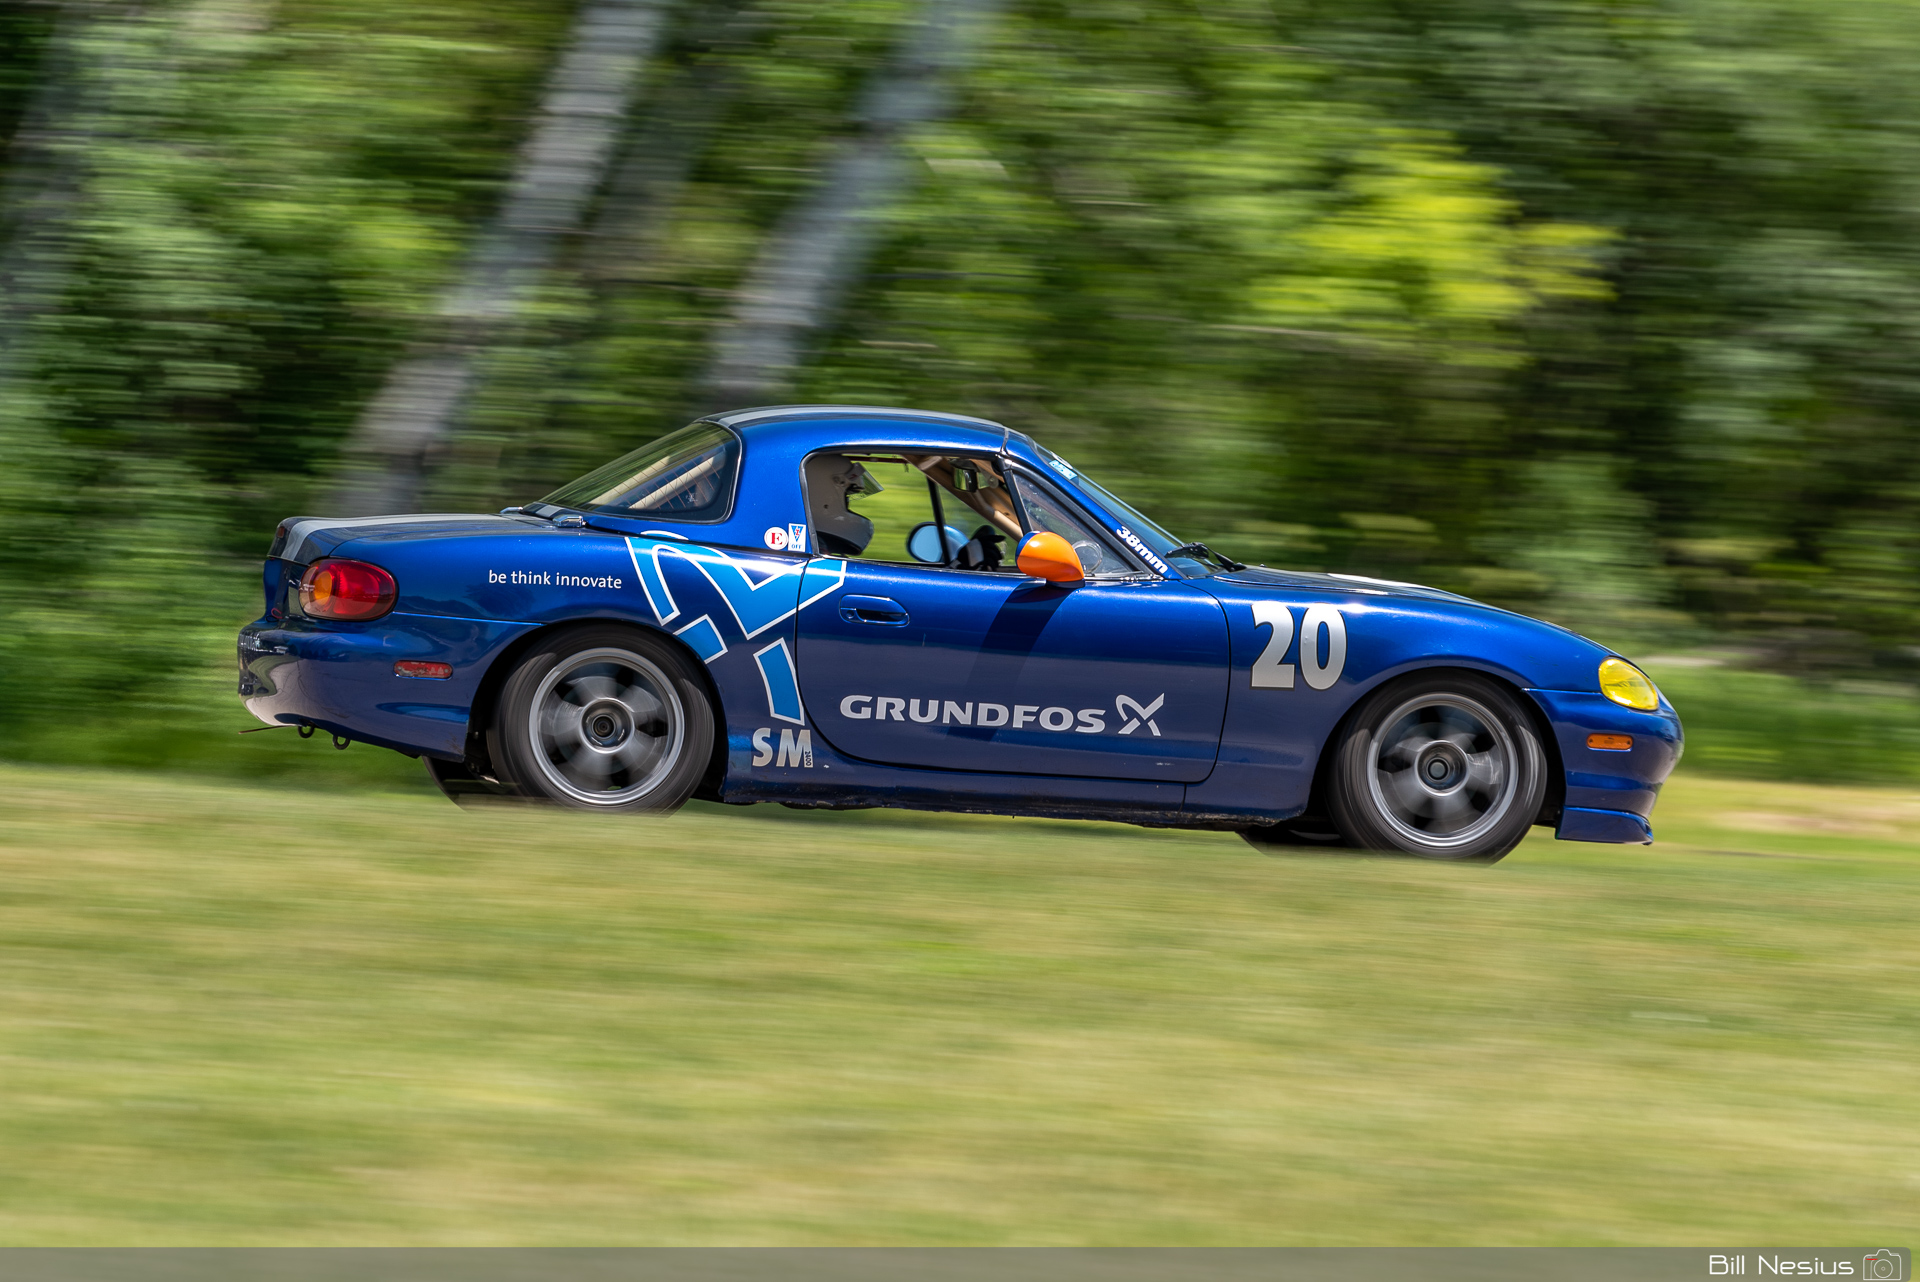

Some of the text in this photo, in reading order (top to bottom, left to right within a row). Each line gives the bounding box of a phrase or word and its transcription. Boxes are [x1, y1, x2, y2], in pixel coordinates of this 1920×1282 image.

[771, 532, 783, 545] E
[1116, 526, 1168, 574] 38mm
[488, 569, 622, 589] be think innovate
[1250, 601, 1348, 692] 20
[840, 694, 1106, 733] GRUNDFOS
[752, 727, 814, 768] SM
